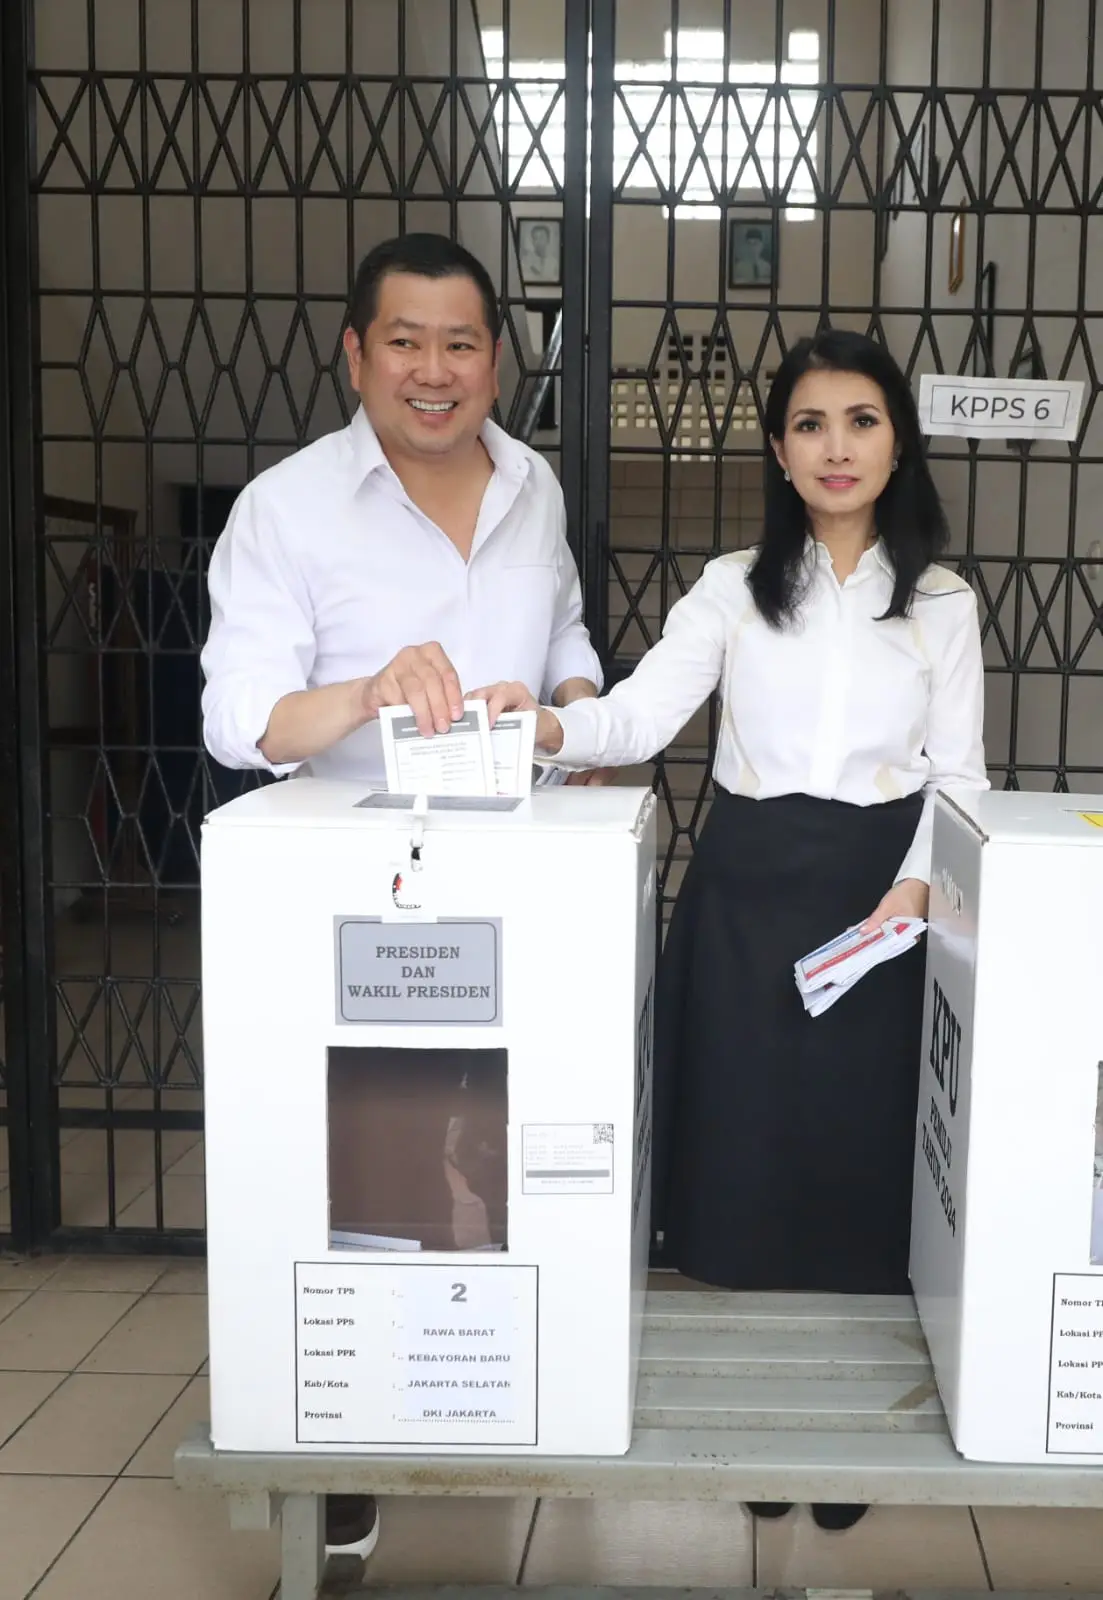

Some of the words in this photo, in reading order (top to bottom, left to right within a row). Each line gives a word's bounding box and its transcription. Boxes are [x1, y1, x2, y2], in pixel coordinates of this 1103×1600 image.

[951, 394, 1025, 419] KPPS
[1034, 399, 1050, 420] 6
[375, 946, 461, 959] PRESIDEN
[401, 966, 436, 978] DAN
[347, 985, 401, 998] WAKIL
[407, 985, 491, 998] PRESIDEN
[929, 976, 961, 1117] KPU
[922, 1122, 941, 1192] TAHUN
[941, 1176, 956, 1238] 2024
[303, 1286, 334, 1295] Nomor
[337, 1287, 355, 1295] TPS
[451, 1282, 467, 1302] 2
[1060, 1298, 1092, 1307] Nomor
[303, 1317, 334, 1326] Lokasi
[336, 1318, 355, 1326] PPS
[423, 1328, 455, 1337] RAWA
[458, 1328, 496, 1337] BARAT
[1059, 1329, 1090, 1338] Lokasi
[303, 1348, 334, 1357] Lokasi
[336, 1349, 356, 1357] PPK
[408, 1354, 477, 1363] KEBAYORAN
[480, 1354, 511, 1363] BARU
[1058, 1360, 1088, 1368] Lokasi
[304, 1380, 349, 1388] Kab/Kota
[407, 1380, 459, 1388] JAKARTA
[1056, 1390, 1102, 1400] Kab/Kota
[304, 1411, 343, 1419] Provinsi
[423, 1409, 442, 1418] DKI
[445, 1409, 497, 1418] JAKARTA
[1055, 1421, 1094, 1430] Provinsi
